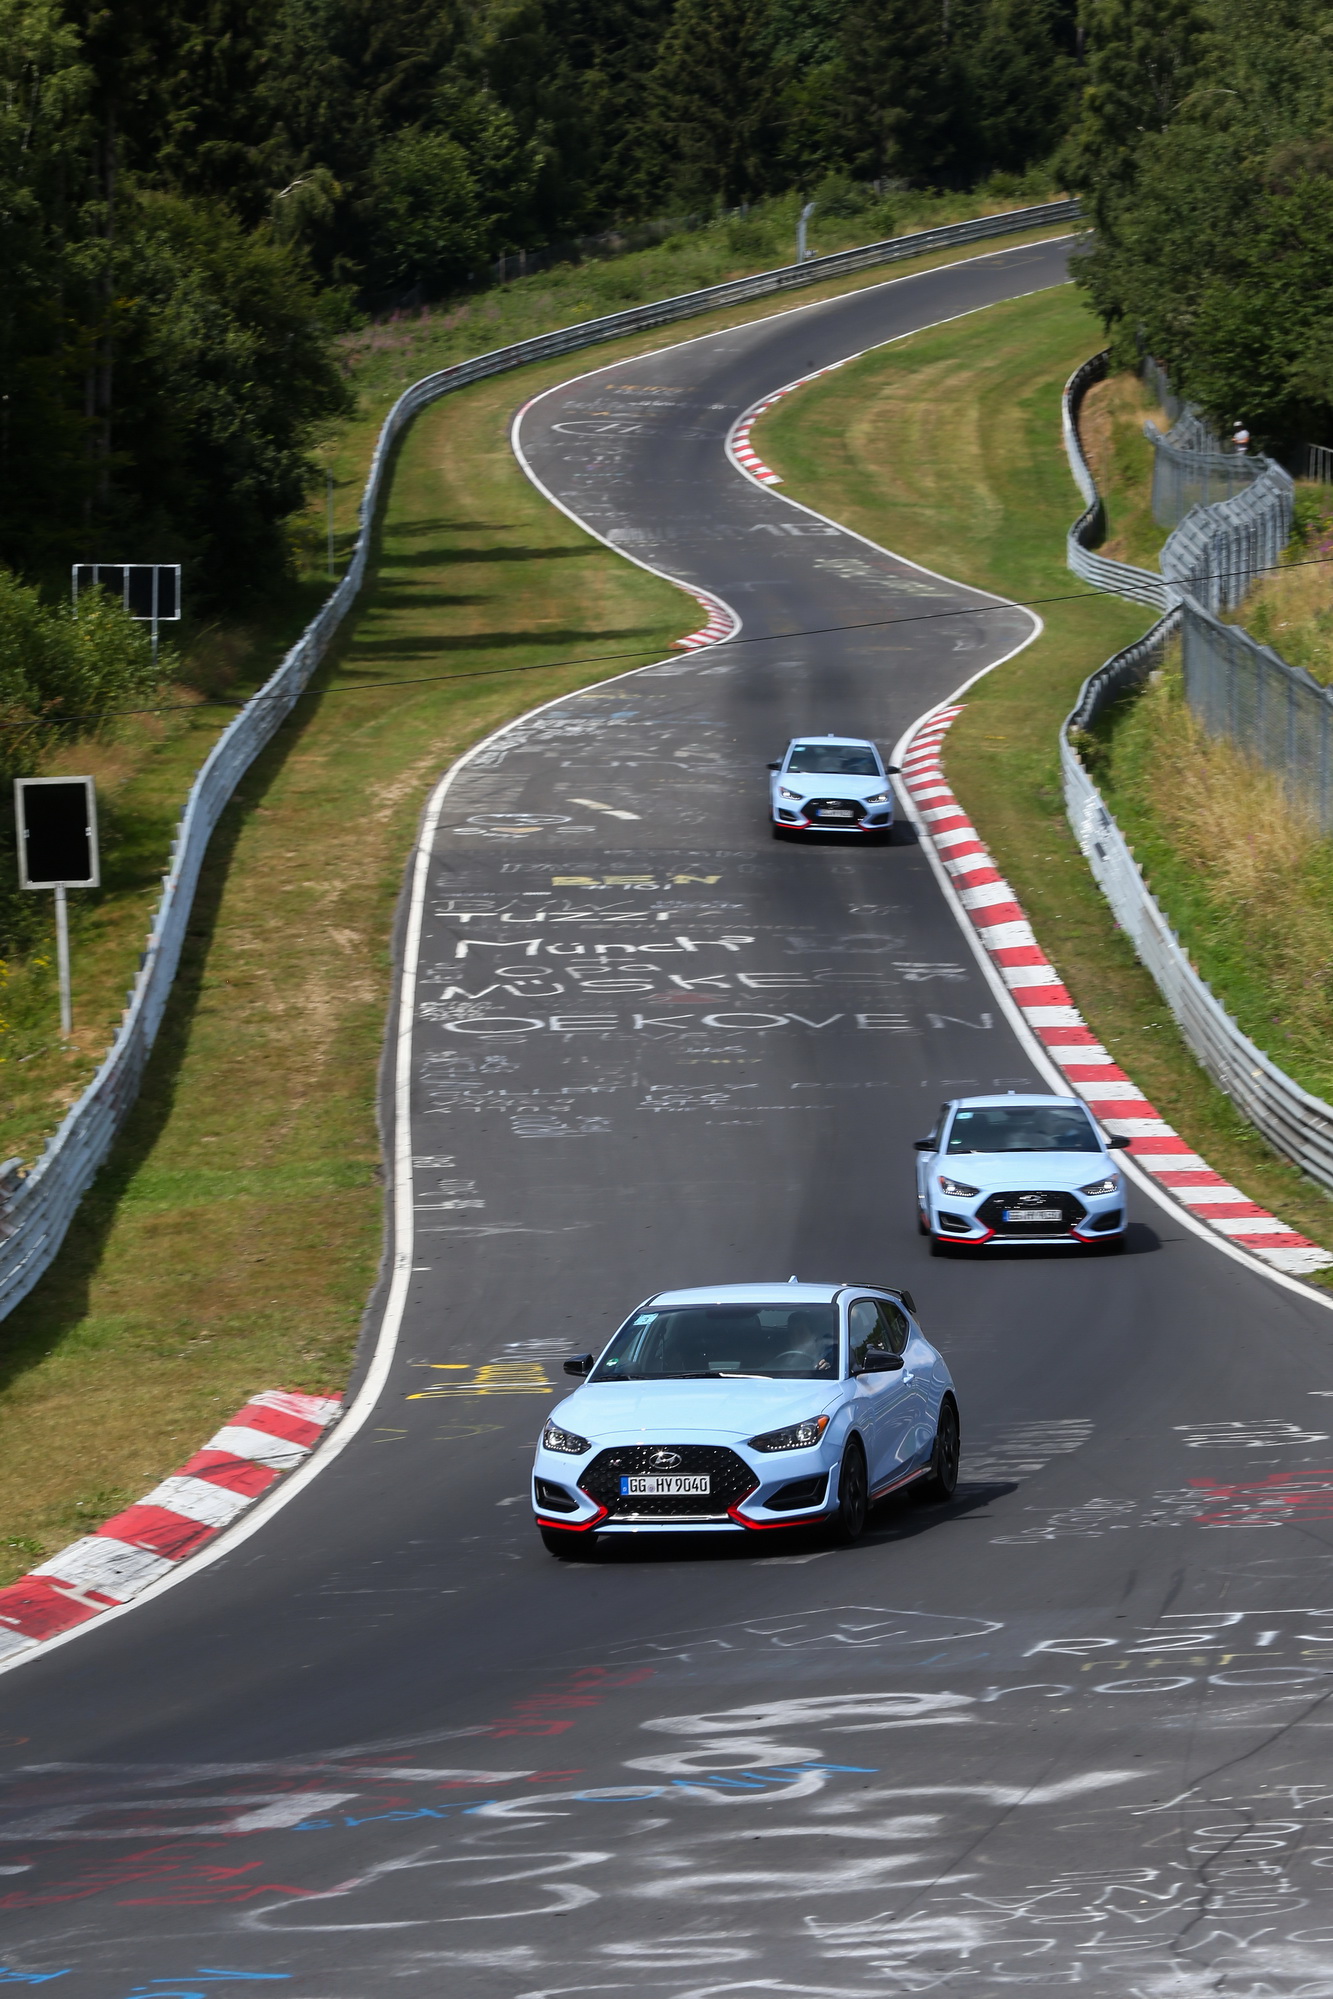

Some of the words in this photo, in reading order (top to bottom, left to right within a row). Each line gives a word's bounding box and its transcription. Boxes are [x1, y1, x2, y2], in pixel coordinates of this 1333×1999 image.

[552, 874, 722, 886] BEN
[442, 1012, 994, 1034] OEKOVEN
[630, 1477, 647, 1492] GG
[656, 1477, 674, 1493] HY
[675, 1476, 708, 1492] 9040
